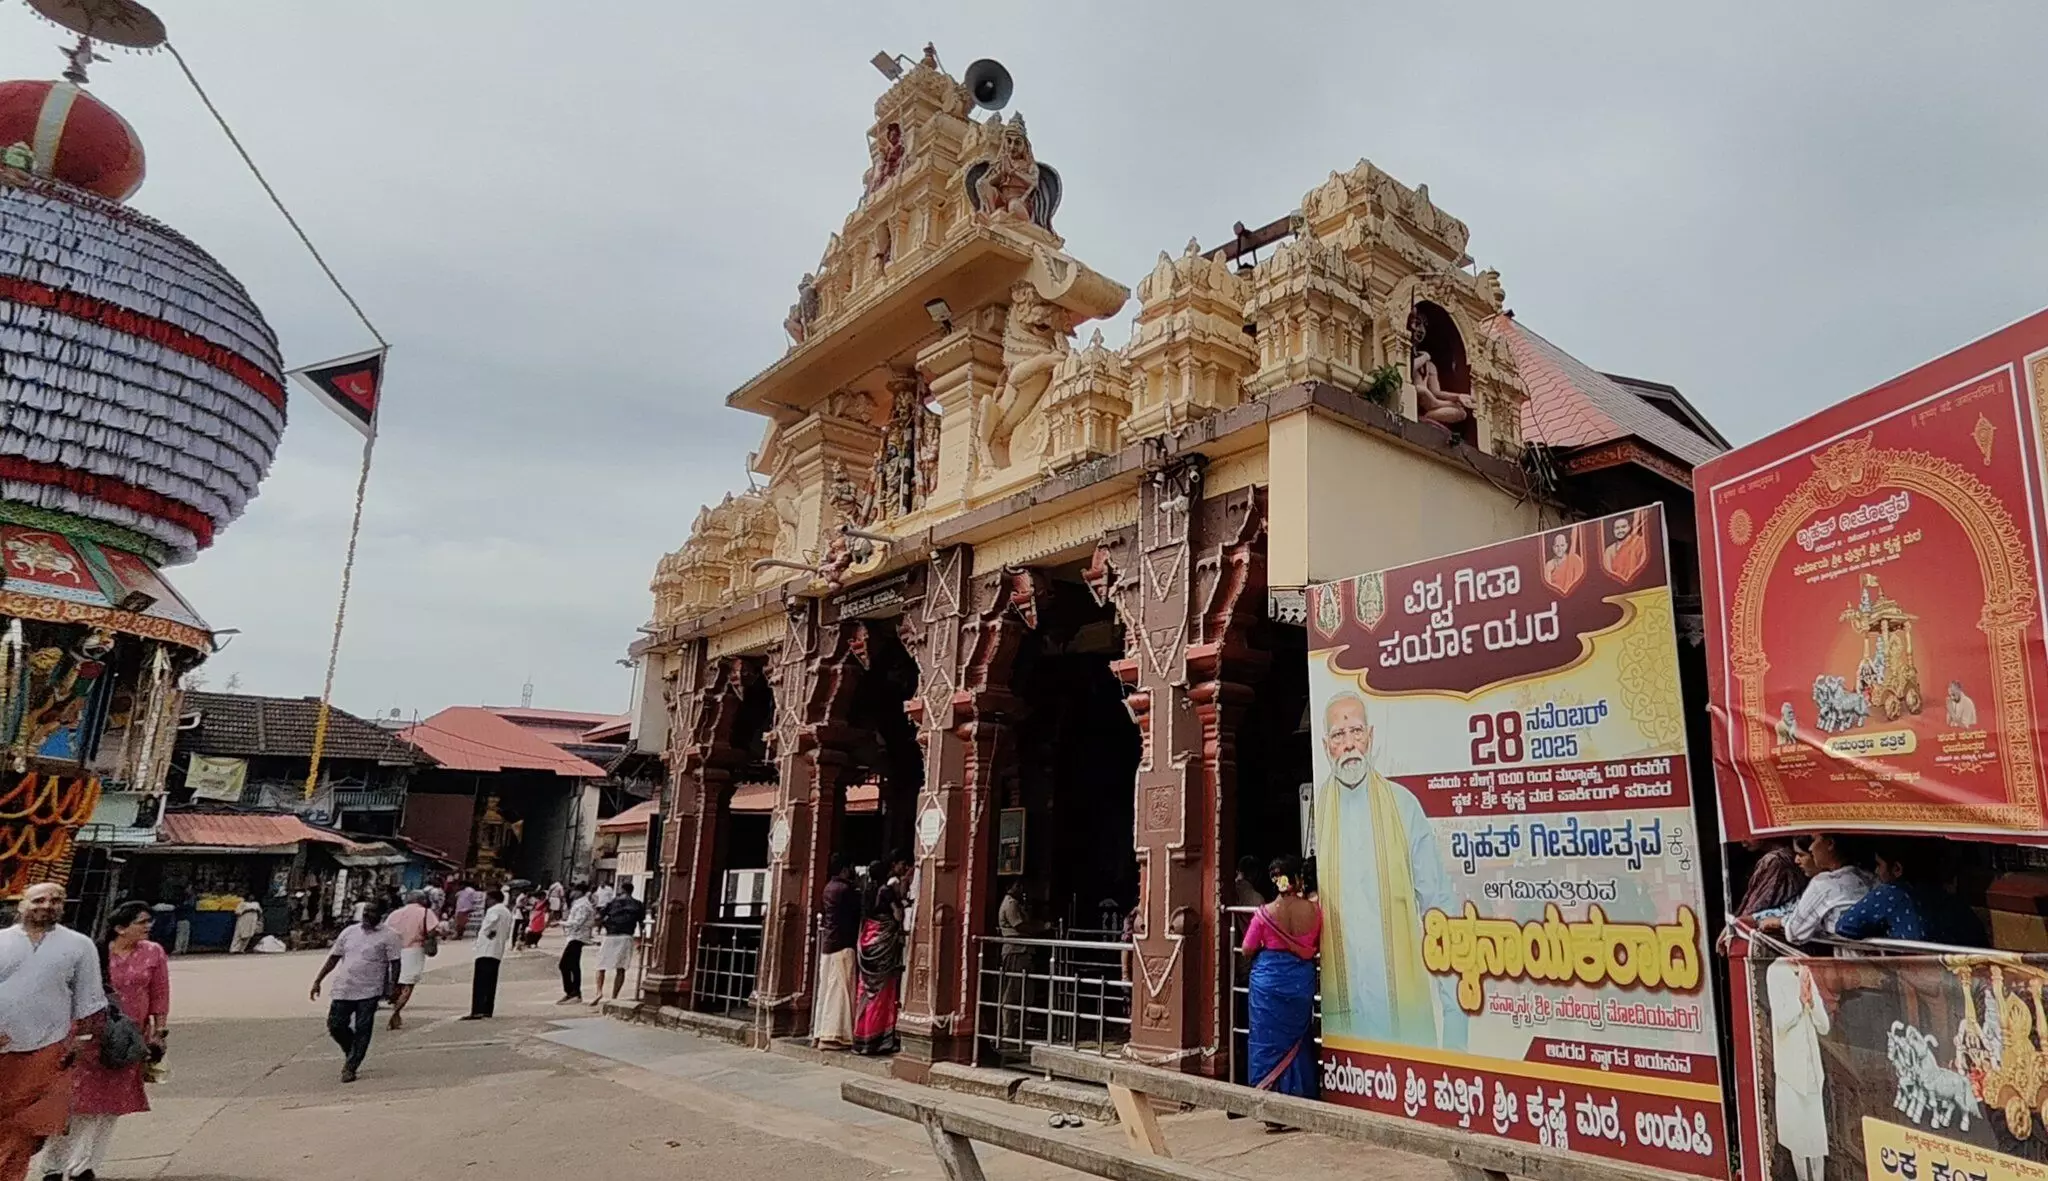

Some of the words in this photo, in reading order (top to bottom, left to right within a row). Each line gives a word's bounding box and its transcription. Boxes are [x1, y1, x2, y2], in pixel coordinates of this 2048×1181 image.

[1796, 515, 1836, 551] ಬೃಹತ್
[1839, 491, 1909, 532] ಗೀತೋತ್ಸವ
[1378, 601, 1560, 667] ಪರ್ಯಾಯದ
[1468, 711, 1524, 765] 28
[1526, 700, 1608, 731] ನವೆಂಬರ್
[1531, 734, 1578, 760] 2025
[1428, 776, 1461, 789] ಸಮಯ
[1498, 772, 1524, 786] 10:00
[1526, 771, 1552, 783] ರಿಂದ
[1630, 758, 1671, 776] ರವರೆಗೆ
[1451, 793, 1472, 815] ಸ್ಥಳ
[1480, 791, 1498, 809] ಶ್ರೀ
[1501, 791, 1527, 811] ಕೃಷ್ಣ
[1529, 788, 1554, 803] ಮಠ
[1624, 780, 1672, 797] ಪರಿಸರ
[1452, 823, 1520, 875] ಬೃಹತ್
[1530, 816, 1662, 871] ಗೀತೋತ್ಸವ
[1484, 879, 1617, 907] ಆಗಮಿಸುತ್ತಿರುವ
[1423, 900, 1701, 1013] ವಿಶ್ವನಾಯಕರಾದ
[1488, 995, 1532, 1026] ಸನ್ಮಾನ್ಯ
[1533, 994, 1552, 1022] ಶ್ರೀ
[1555, 995, 1603, 1028] ನರೇಂದ್ರ
[1606, 1001, 1700, 1031] ಮೋದಿಯವರಿಗೆ
[1590, 1047, 1629, 1071] ಸ್ವಾಗತ
[1634, 1052, 1691, 1074] ಬಯಸುವ
[1323, 1058, 1398, 1102] ಪರ್ಯಾಯ
[1403, 1067, 1427, 1117] ಶ್ರೀ
[1433, 1071, 1485, 1128] ಪುತ್ತಿಗೆ
[1492, 1081, 1519, 1135] ಶ್ರೀ
[1525, 1085, 1570, 1151] ಕೃಷ್ಣ
[1575, 1094, 1627, 1147] ಮಠ,
[1635, 1105, 1714, 1156] ಉಡುಪಿ
